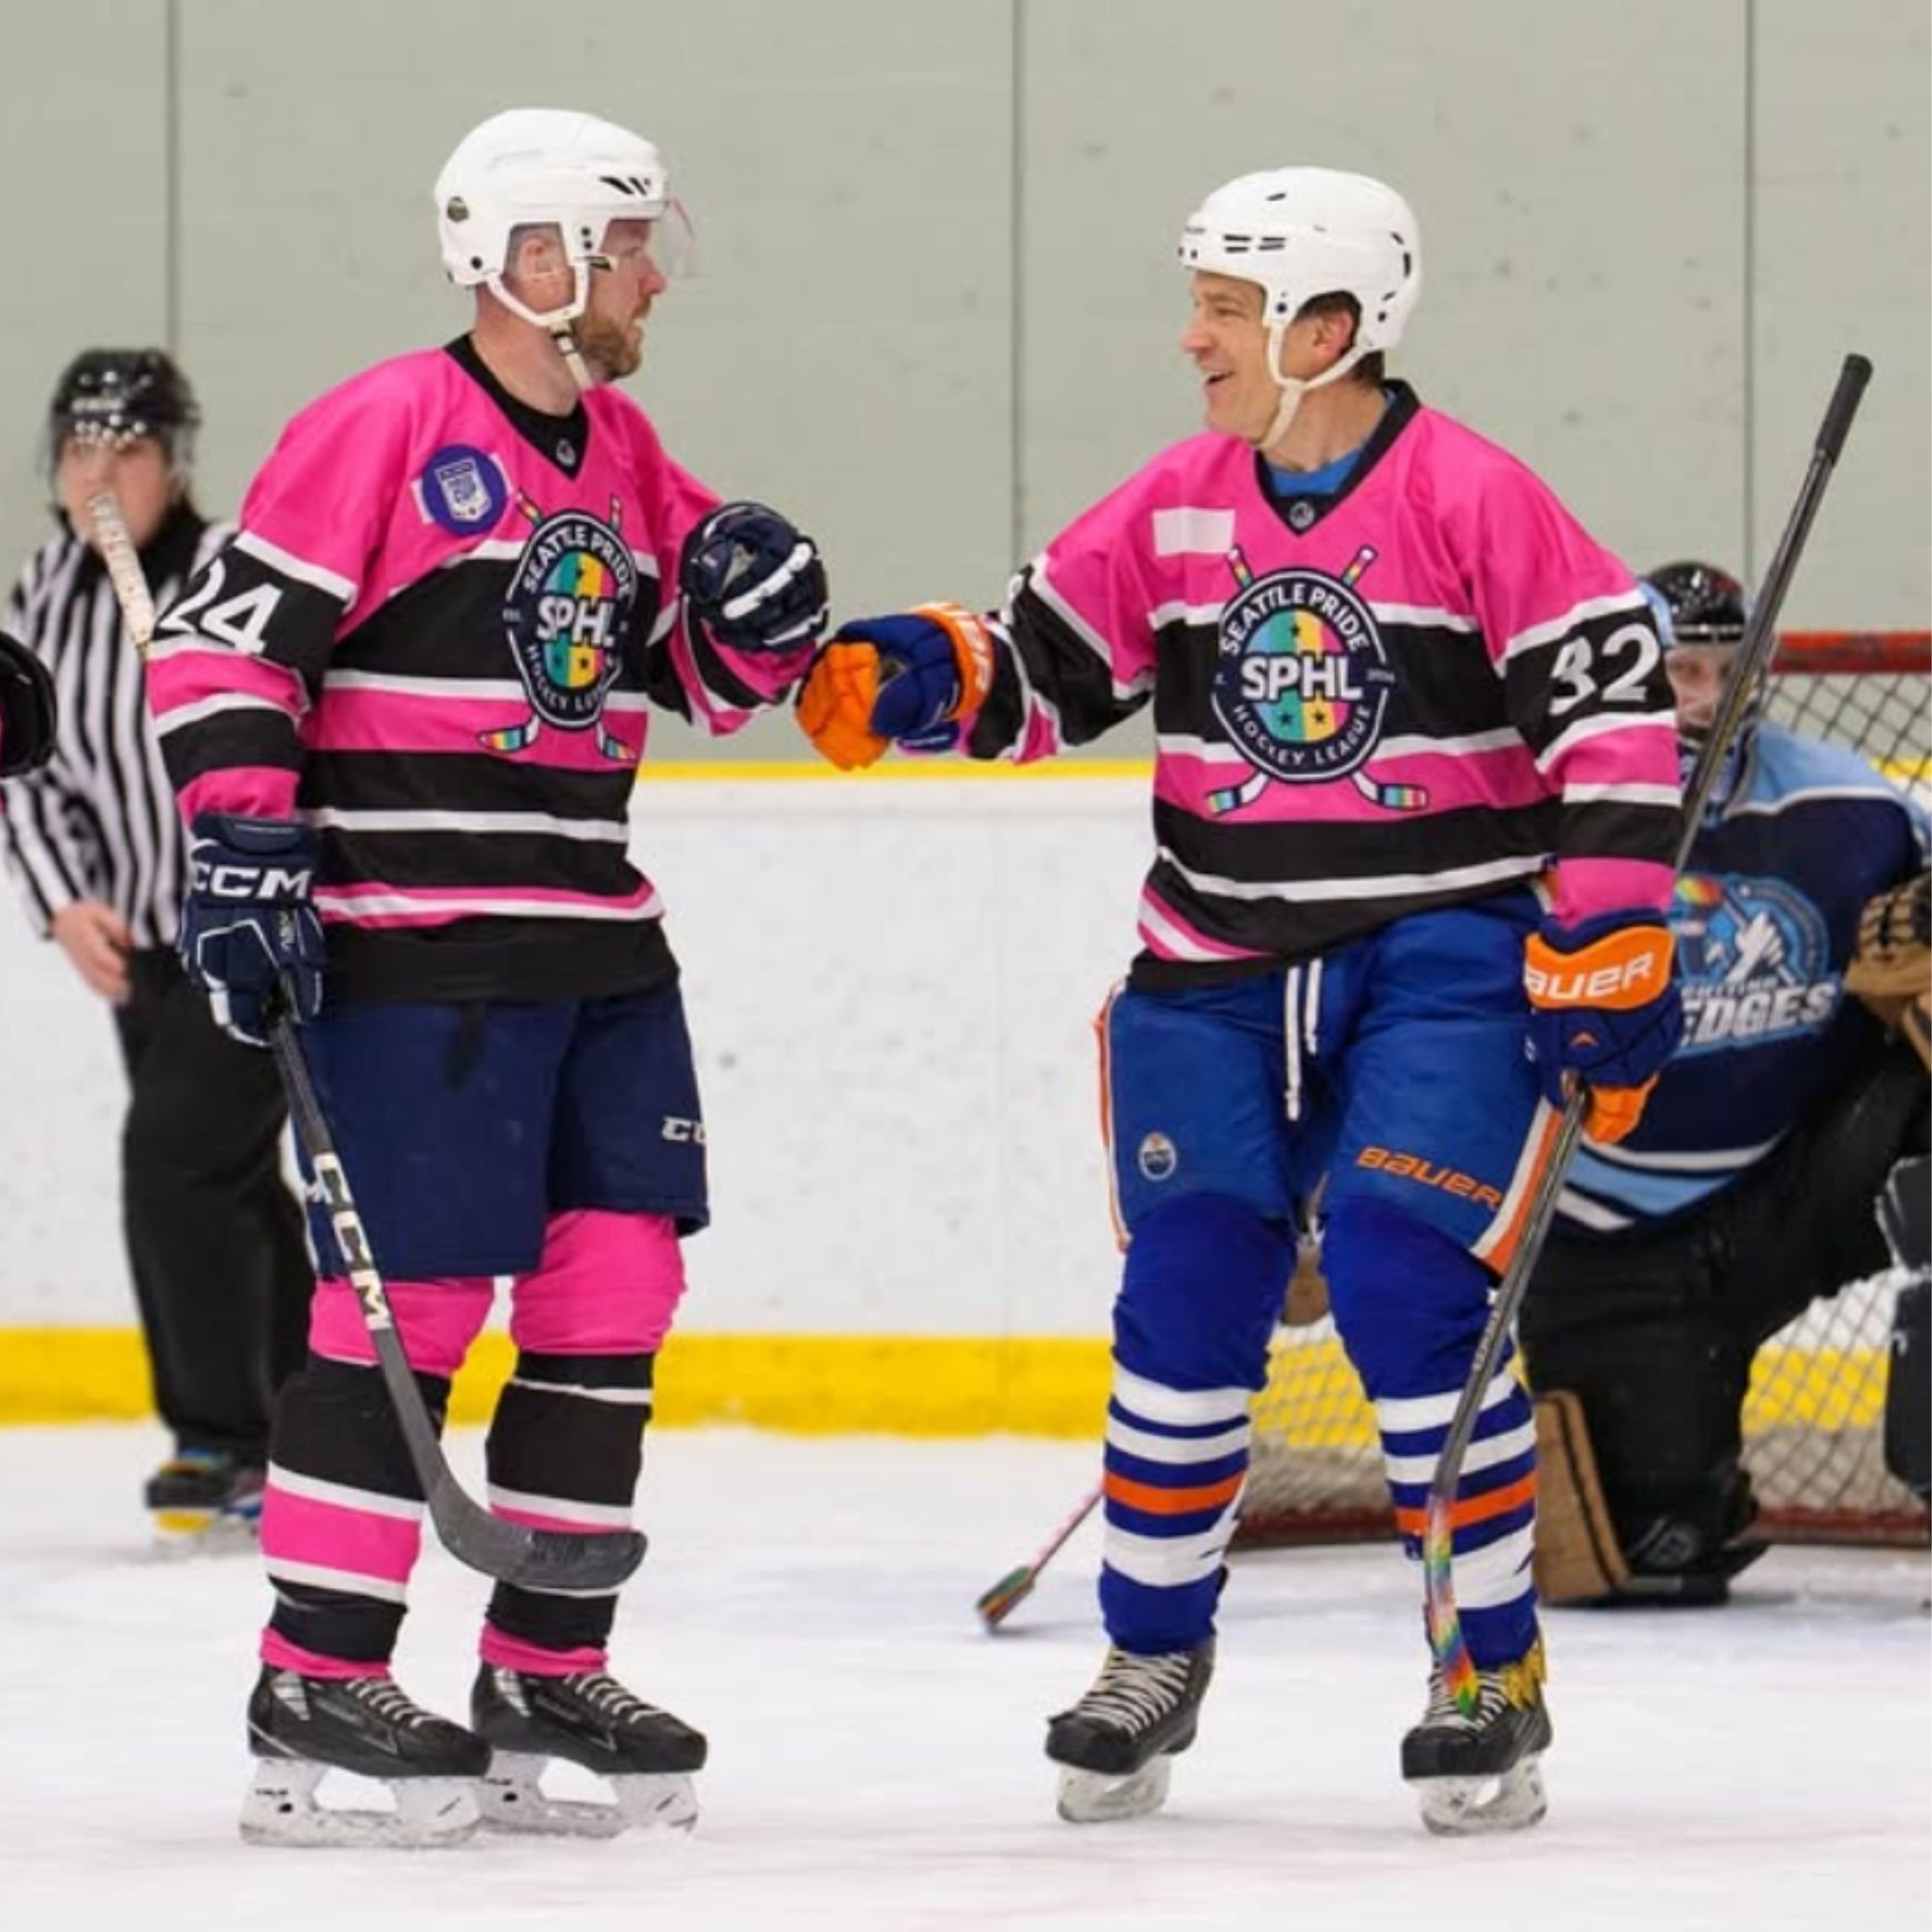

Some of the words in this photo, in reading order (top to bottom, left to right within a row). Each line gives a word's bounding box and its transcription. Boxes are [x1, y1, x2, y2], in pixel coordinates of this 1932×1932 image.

[158, 557, 283, 653] 24
[1221, 583, 1307, 655] SEATTLE
[1309, 588, 1370, 652] PRIDE
[1241, 655, 1363, 700] SPHL
[1233, 705, 1304, 764] HOCKEY
[1315, 706, 1371, 764] LEAGUE
[1525, 951, 1654, 999] AUER
[1358, 1146, 1504, 1211] BAUER
[313, 1152, 392, 1330] CCM
